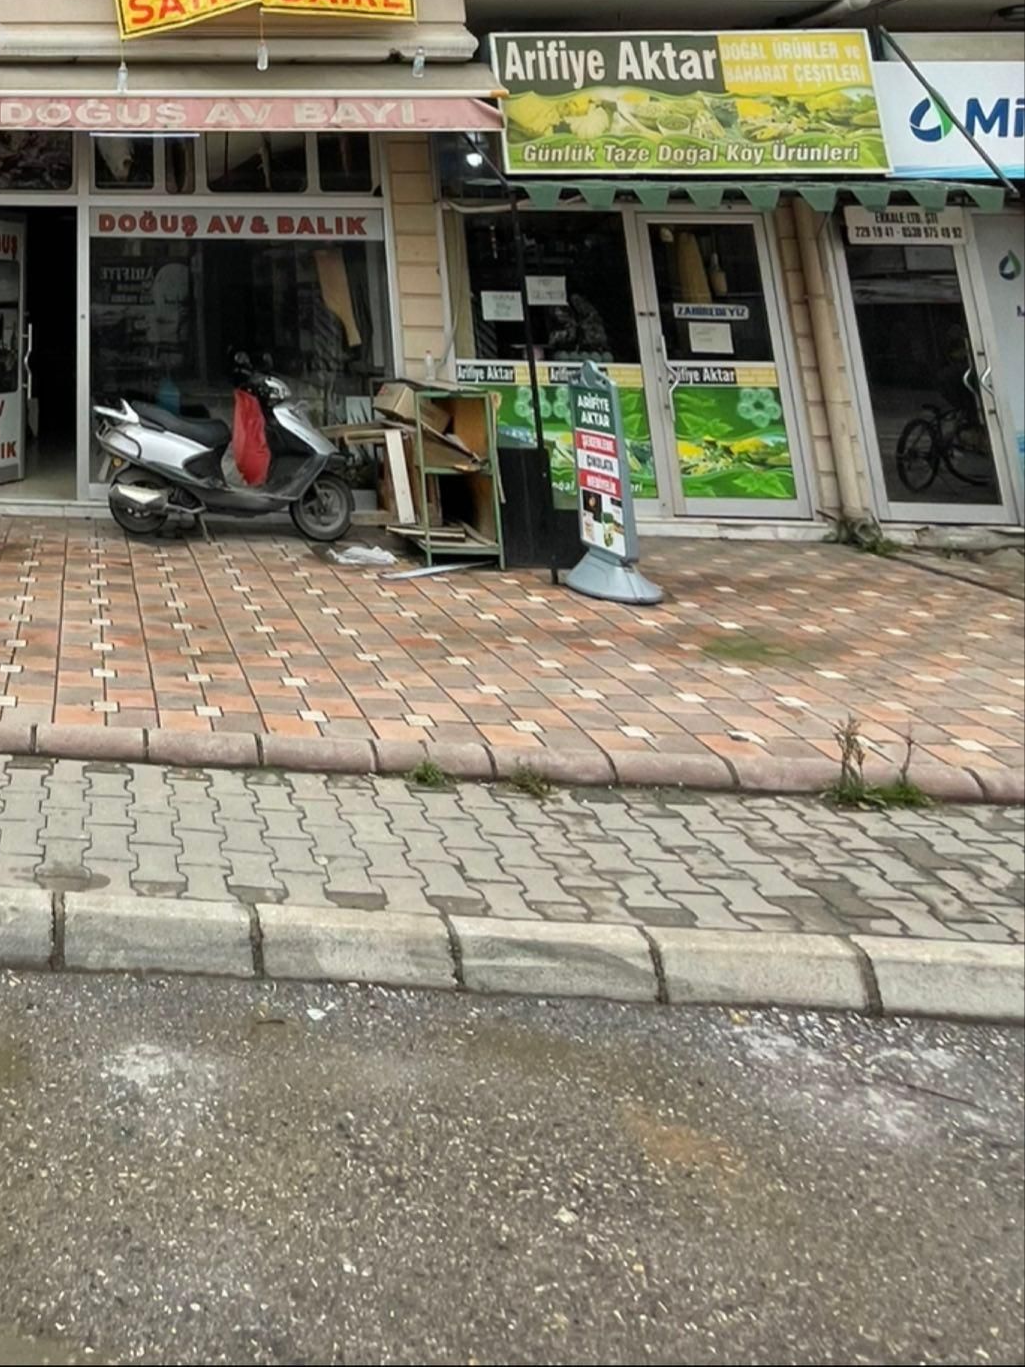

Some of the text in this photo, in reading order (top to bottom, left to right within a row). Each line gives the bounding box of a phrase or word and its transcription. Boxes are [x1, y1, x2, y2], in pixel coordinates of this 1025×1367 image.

[505, 39, 718, 88] Arifiye Aktar
[204, 102, 272, 124] AV
[524, 142, 596, 163] Günlük
[604, 144, 650, 163] Taze
[657, 143, 719, 168] Doğal
[771, 140, 859, 162] Ürünleri
[98, 211, 368, 237] DOĞUŞ AV & BALIK
[486, 365, 514, 381] Aktar
[702, 368, 736, 383] Aktar
